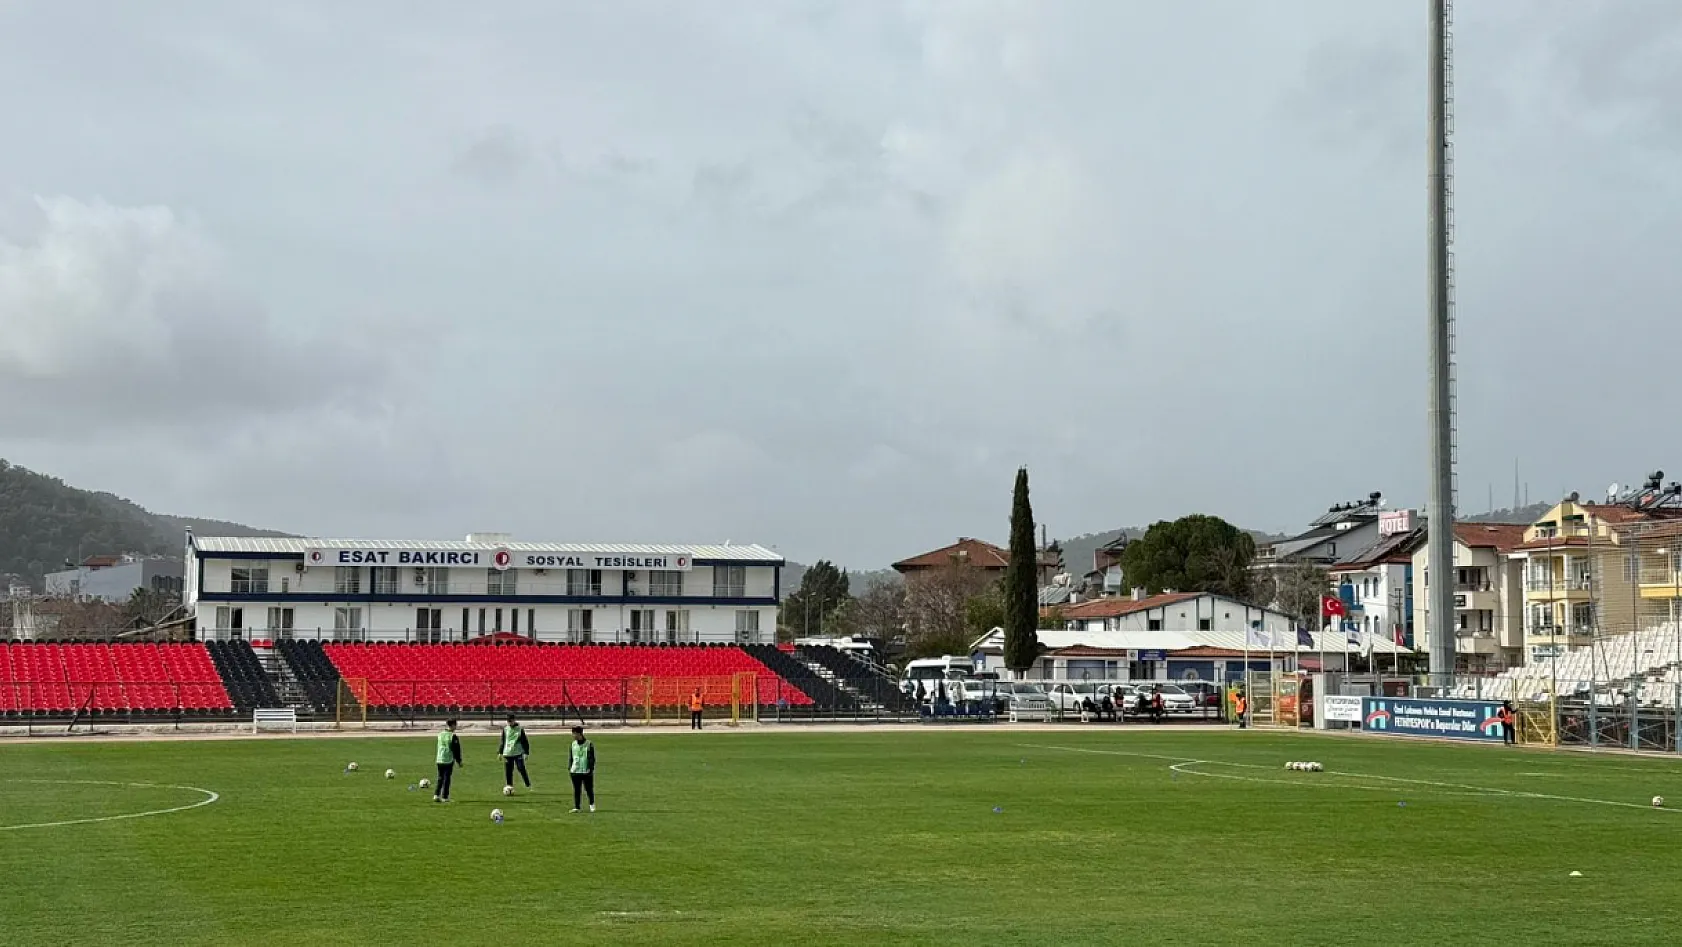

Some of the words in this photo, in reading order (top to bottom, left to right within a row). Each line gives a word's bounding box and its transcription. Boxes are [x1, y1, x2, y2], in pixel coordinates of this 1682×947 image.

[1379, 518, 1409, 534] HOTEL
[339, 550, 389, 563] ESAT
[399, 551, 479, 565] BAKIRCI
[526, 555, 584, 566] SOSYAL
[595, 554, 667, 567] TESİSLERİ
